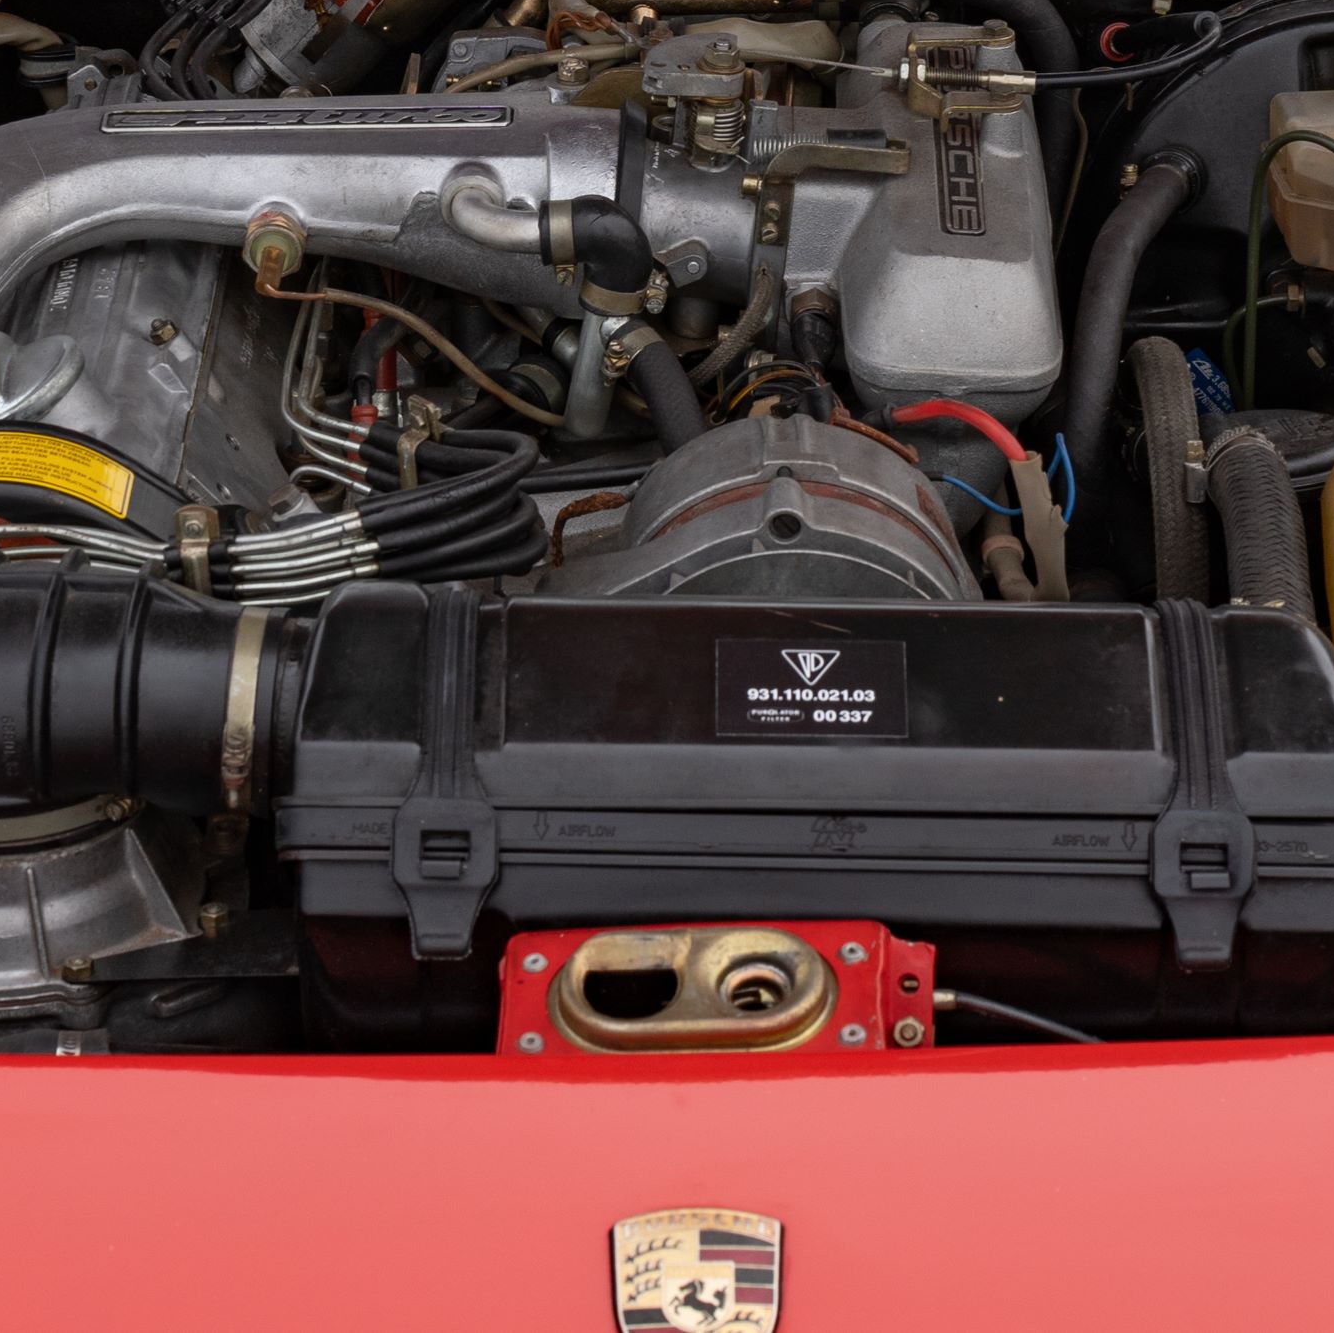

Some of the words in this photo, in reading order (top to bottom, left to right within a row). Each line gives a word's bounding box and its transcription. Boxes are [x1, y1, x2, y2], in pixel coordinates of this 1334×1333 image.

[947, 46, 979, 229] PSCHE
[747, 687, 876, 702] 931.110.021.03
[558, 825, 617, 838] AIRFLOW
[1052, 834, 1111, 847] AIRFLOW
